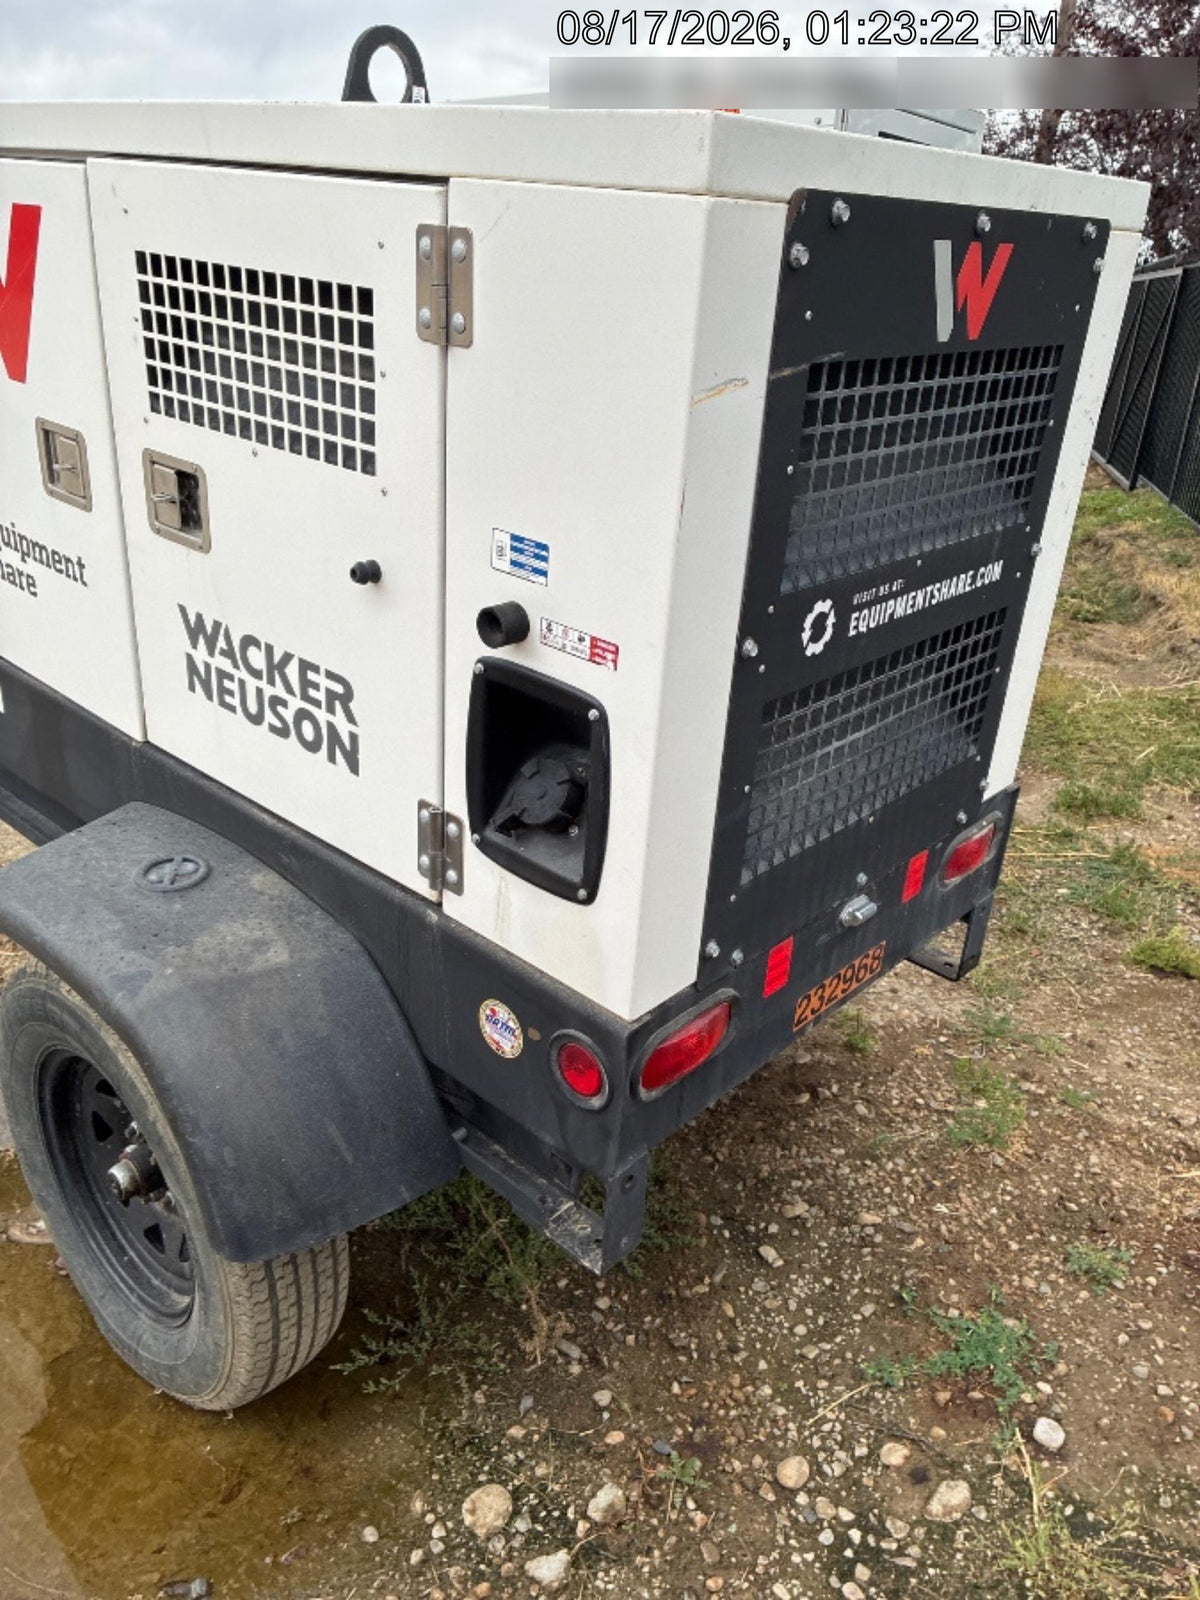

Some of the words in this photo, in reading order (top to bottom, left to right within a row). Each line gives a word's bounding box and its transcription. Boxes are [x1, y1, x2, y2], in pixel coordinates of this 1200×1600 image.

[0, 521, 88, 588] uipment
[848, 559, 1004, 637] EQUIPMENTSHARE.COM
[177, 602, 360, 728] WACKER
[185, 651, 360, 778] NEUSON
[794, 945, 883, 1028] 232968
